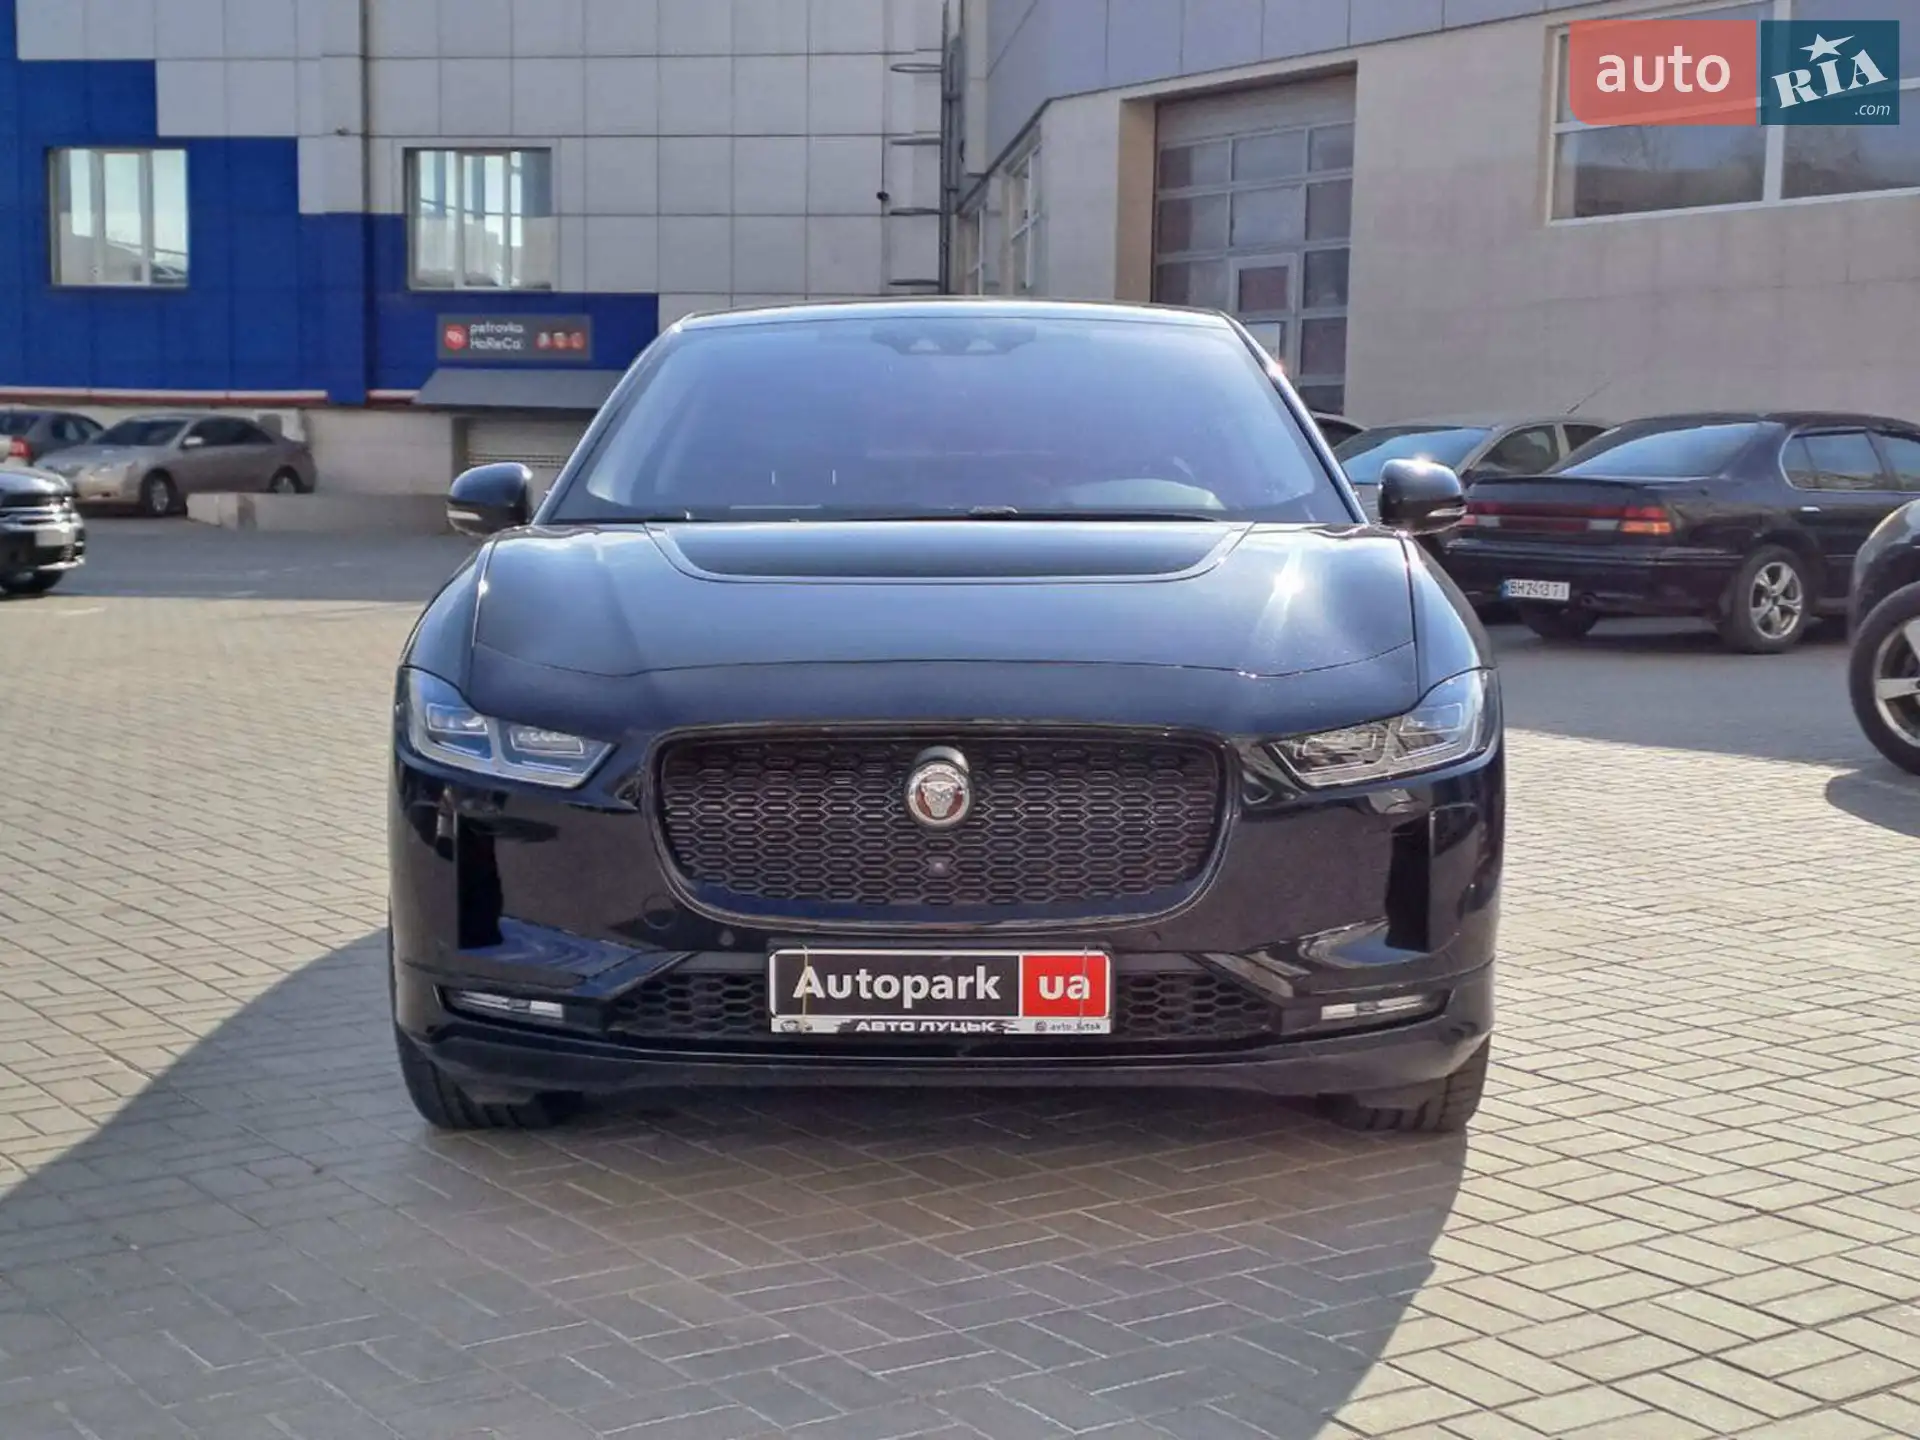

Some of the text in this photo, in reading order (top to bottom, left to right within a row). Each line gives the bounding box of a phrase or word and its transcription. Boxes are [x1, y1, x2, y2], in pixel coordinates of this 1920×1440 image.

[793, 965, 1000, 1008] Autopark
[1038, 974, 1090, 1000] ua
[855, 1021, 996, 1034] АВТО ЛУЦЬК
